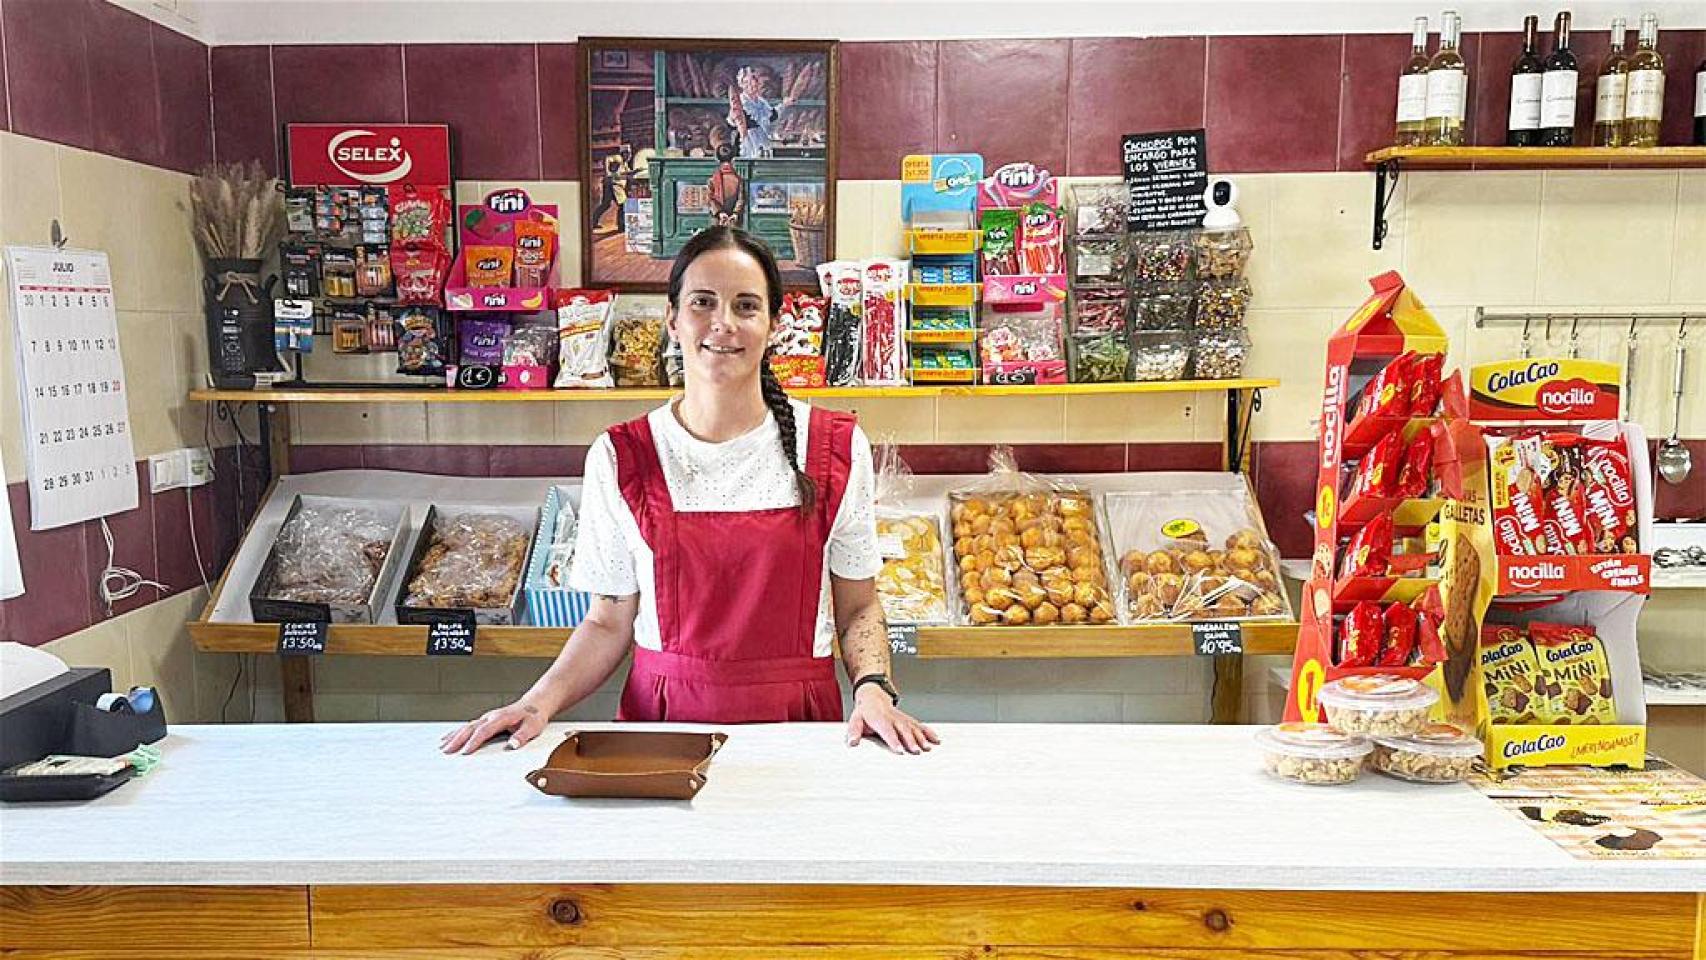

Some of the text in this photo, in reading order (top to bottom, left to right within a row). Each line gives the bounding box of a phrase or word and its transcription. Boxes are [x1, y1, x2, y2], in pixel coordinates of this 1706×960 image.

[1177, 136, 1197, 146] POR
[338, 144, 402, 162] SELEX
[1170, 147, 1197, 158] PARA
[1131, 162, 1149, 172] LOS
[1000, 169, 1035, 186] Fini
[490, 191, 525, 213] Fini
[520, 235, 542, 248] Fini
[52, 261, 74, 273] JULIO
[1014, 283, 1037, 295] Fini
[484, 293, 506, 308] Fini
[31, 341, 36, 353] 7
[1487, 362, 1559, 394] ColaCao
[1541, 387, 1596, 405] nocilla
[1323, 367, 1345, 468] nocilla
[1601, 459, 1630, 502] nocilla
[1444, 504, 1486, 526] GALLETAS
[1508, 562, 1565, 579] nocilla
[1482, 642, 1524, 665] olaCao
[1546, 641, 1594, 663] ColaCao
[1503, 734, 1566, 758] ColaCao
